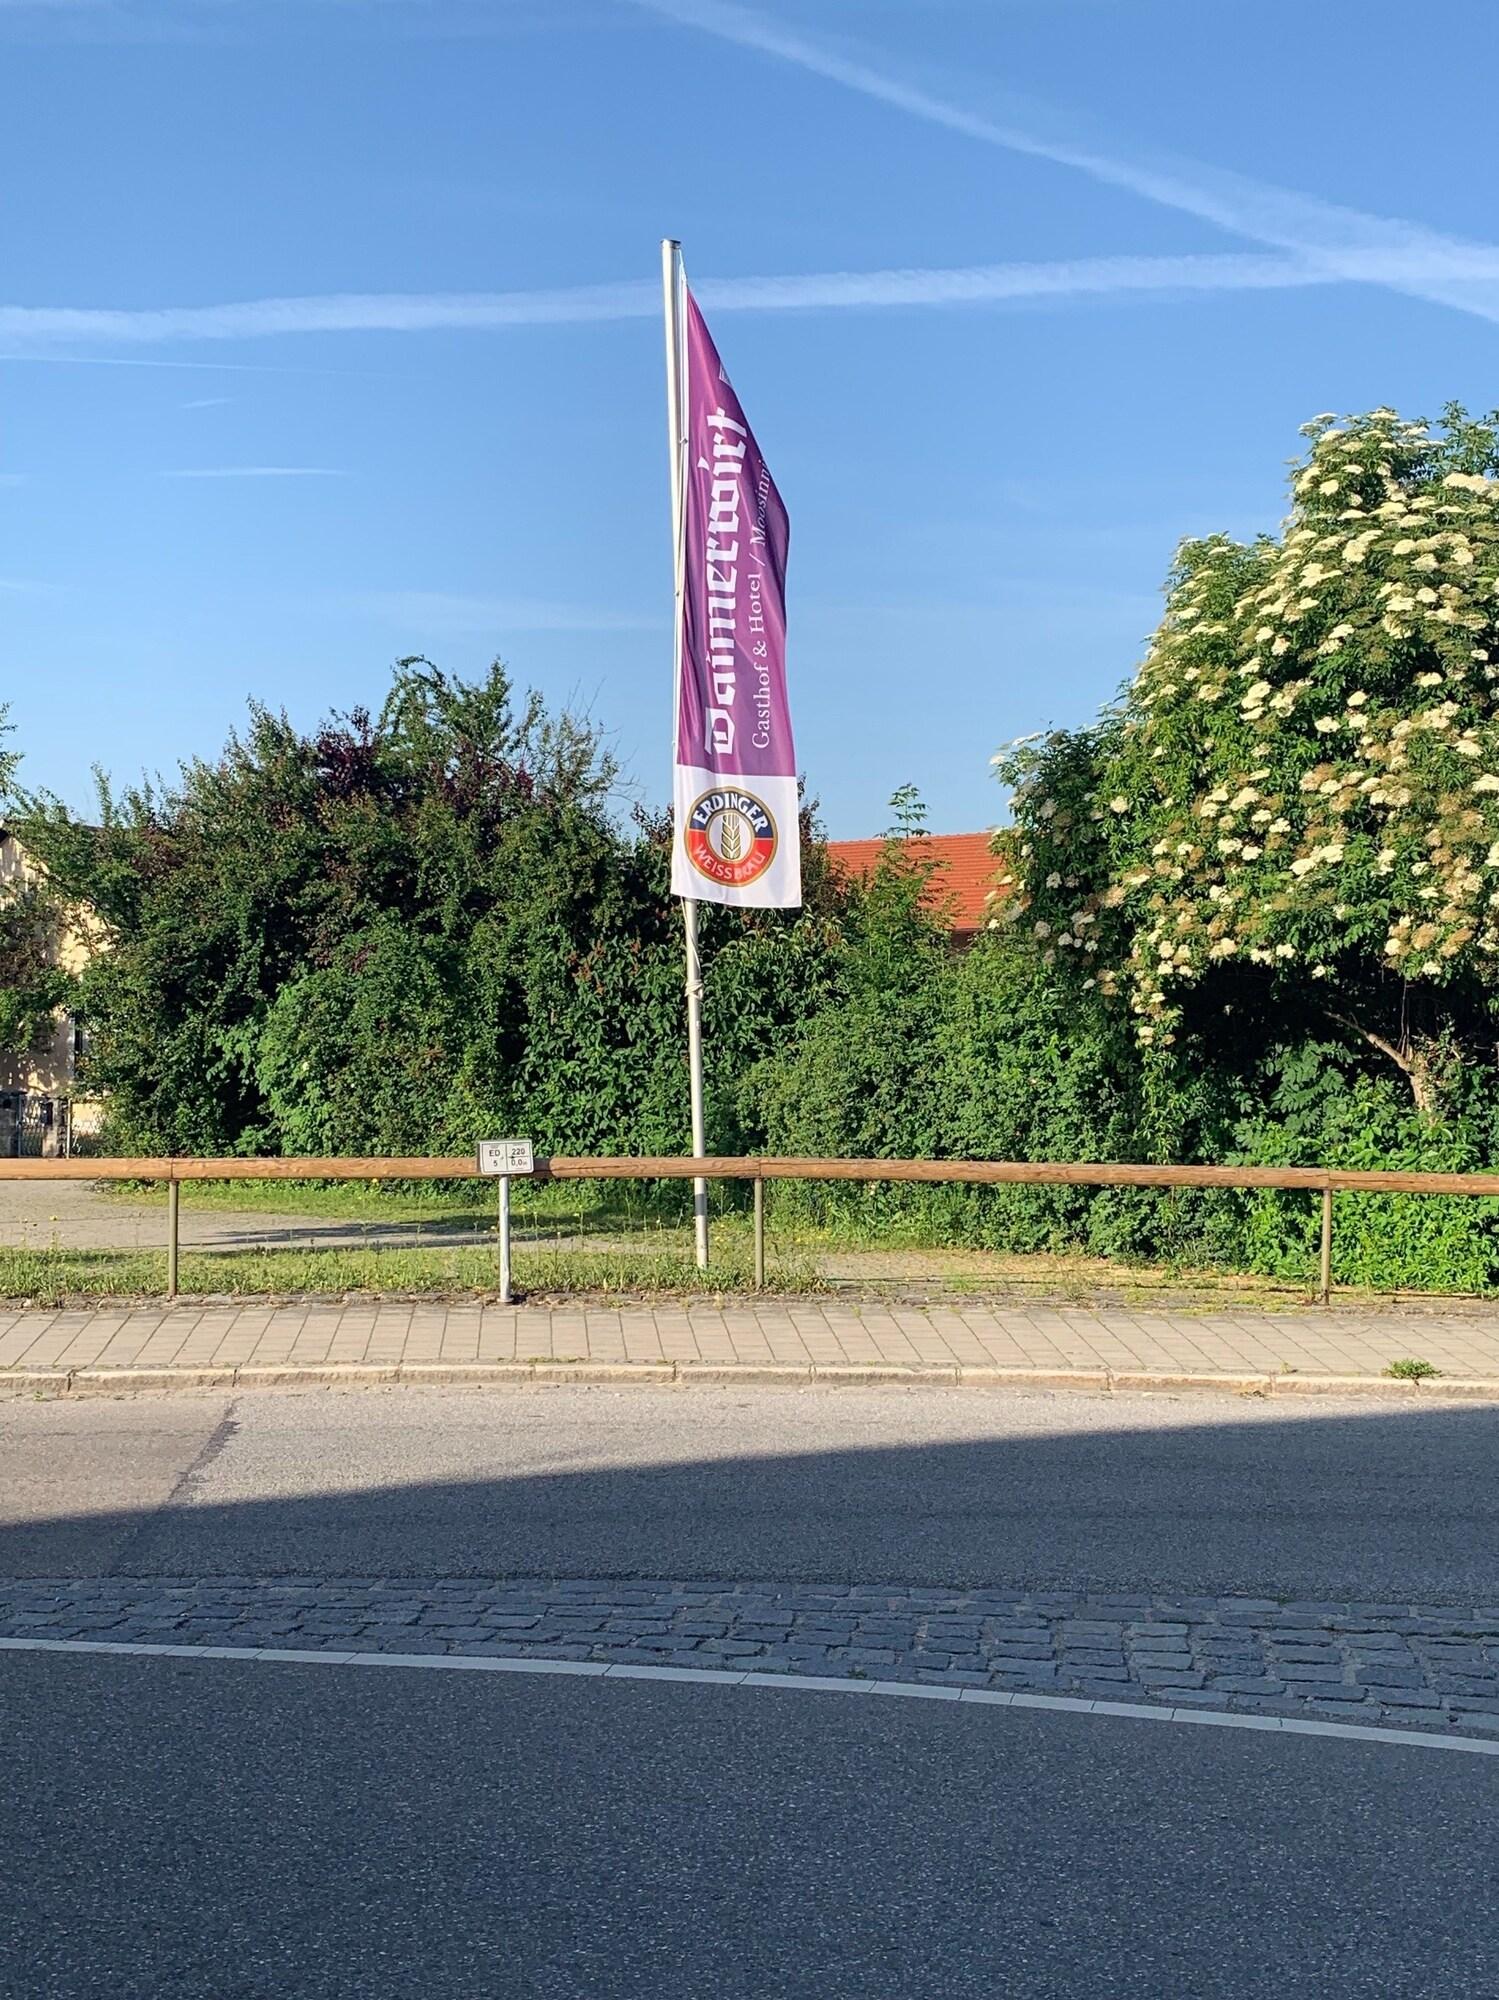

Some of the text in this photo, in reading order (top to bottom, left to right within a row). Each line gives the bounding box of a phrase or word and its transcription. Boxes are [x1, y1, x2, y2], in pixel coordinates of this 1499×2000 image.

[697, 407, 747, 755] Daimerwirt
[748, 574, 765, 632] Hotel
[753, 641, 767, 657] &
[752, 663, 770, 748] Gasthof
[693, 792, 768, 832] ERDINGER
